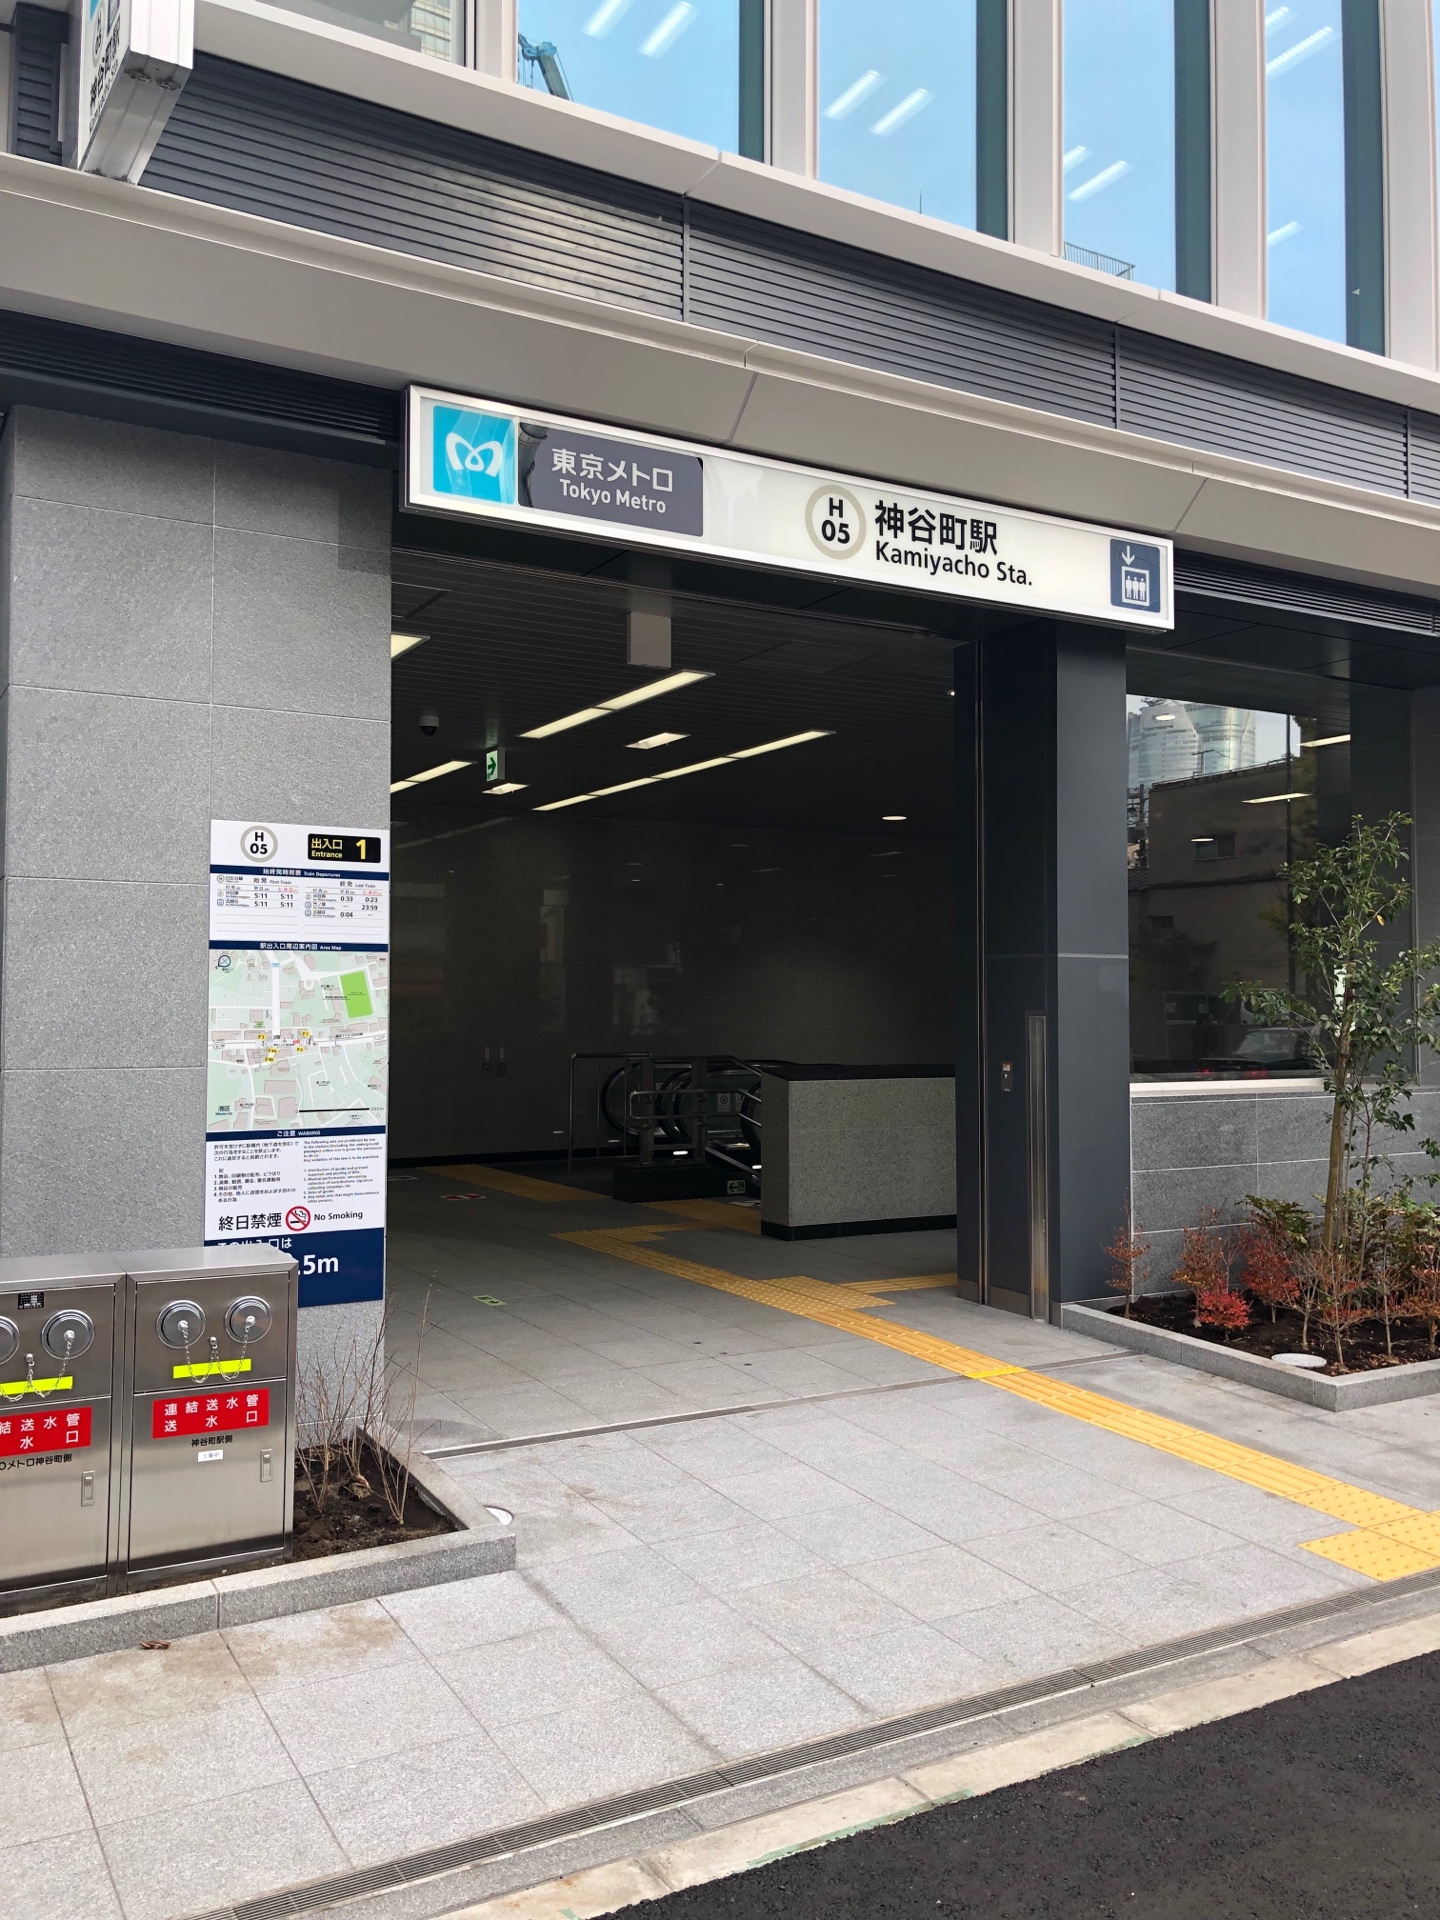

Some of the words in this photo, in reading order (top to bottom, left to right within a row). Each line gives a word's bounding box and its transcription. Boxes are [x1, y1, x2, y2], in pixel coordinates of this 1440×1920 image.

[551, 448, 673, 492] 東京メトロ
[559, 478, 611, 505] Tokyo
[616, 489, 666, 513] Metro
[829, 497, 844, 519] H
[821, 519, 850, 544] 05
[875, 500, 998, 556] 神谷町駅
[876, 540, 989, 579] Kamiyacho
[996, 561, 1033, 586] Sta.
[254, 832, 264, 842] H
[250, 843, 268, 855] 05
[311, 838, 343, 850] 出入口
[355, 839, 366, 860] 1
[311, 850, 343, 859] Entrance
[218, 1213, 282, 1232] 終日禁煙
[313, 1213, 326, 1221] No
[328, 1211, 363, 1220] Smoking
[164, 1394, 259, 1416] 連結送水管
[164, 1410, 258, 1433] 送水口
[191, 1434, 233, 1448] 神谷町駅側
